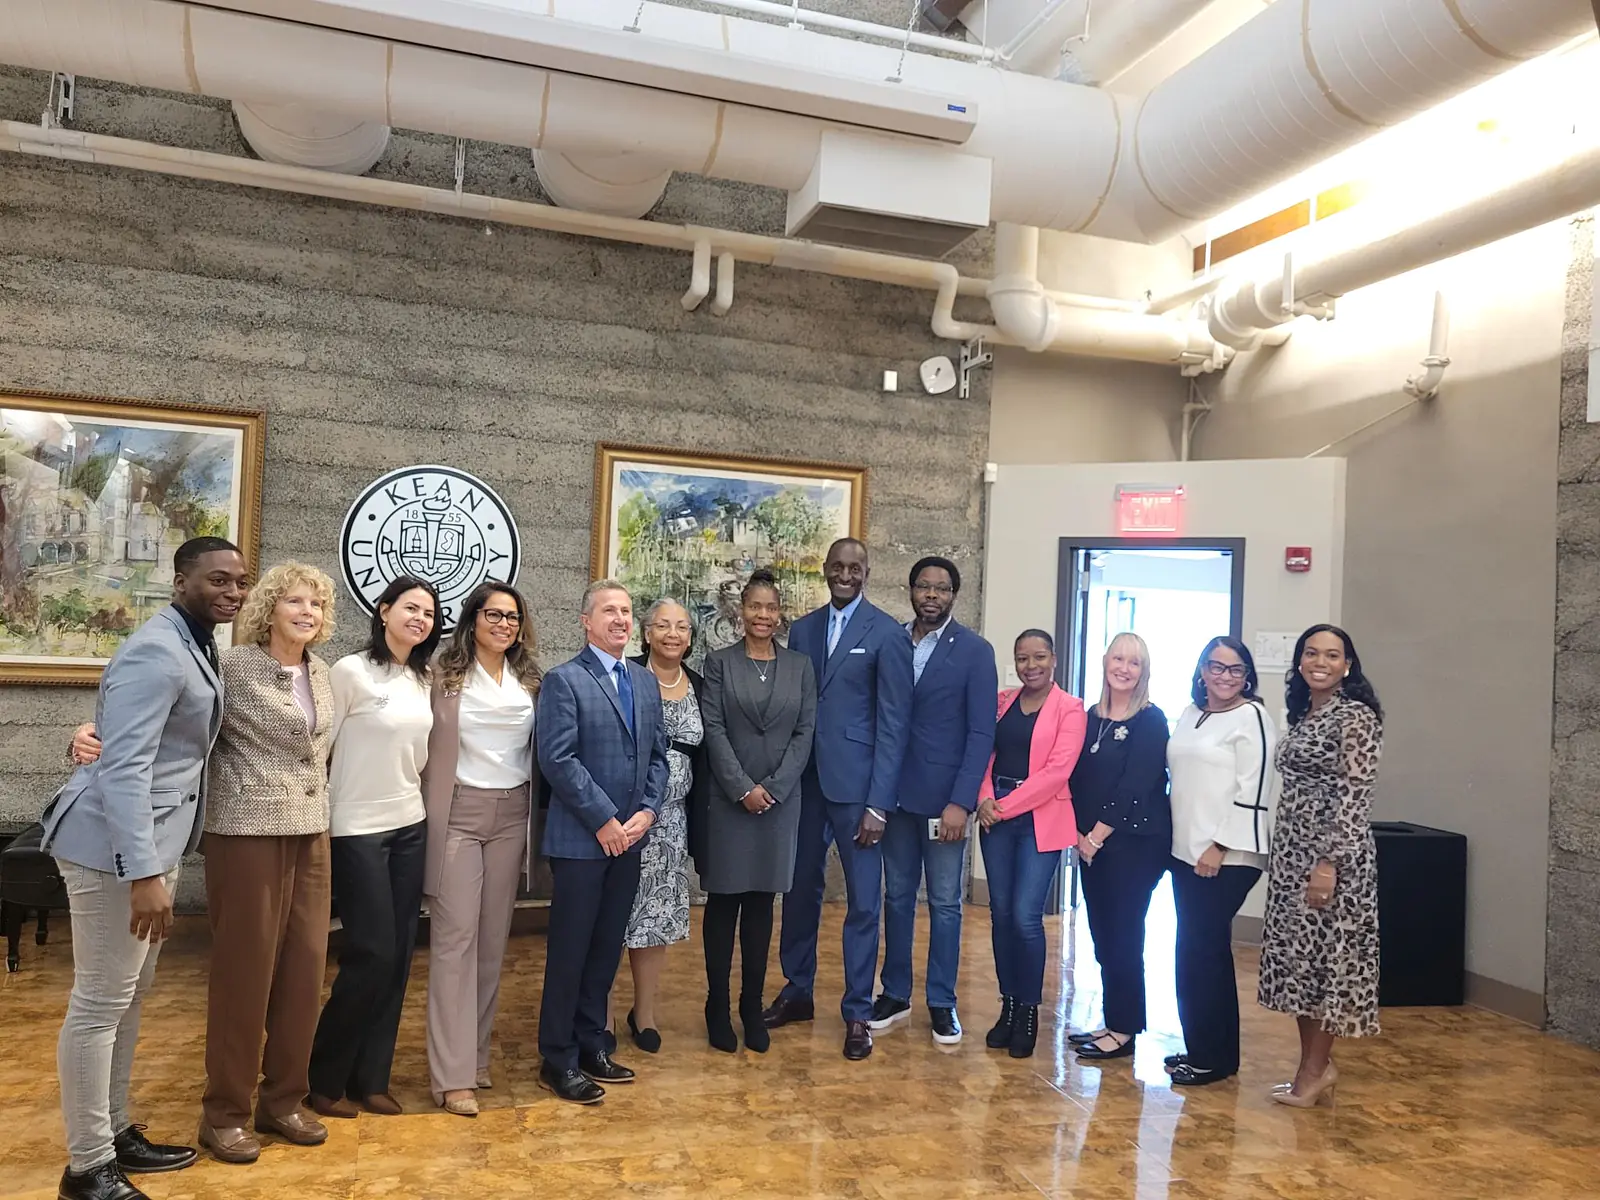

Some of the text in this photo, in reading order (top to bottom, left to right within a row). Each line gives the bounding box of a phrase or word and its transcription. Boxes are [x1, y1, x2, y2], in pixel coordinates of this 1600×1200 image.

[385, 477, 484, 512] KEAN
[405, 509, 462, 522] 18 55
[1131, 497, 1172, 525] EXIT
